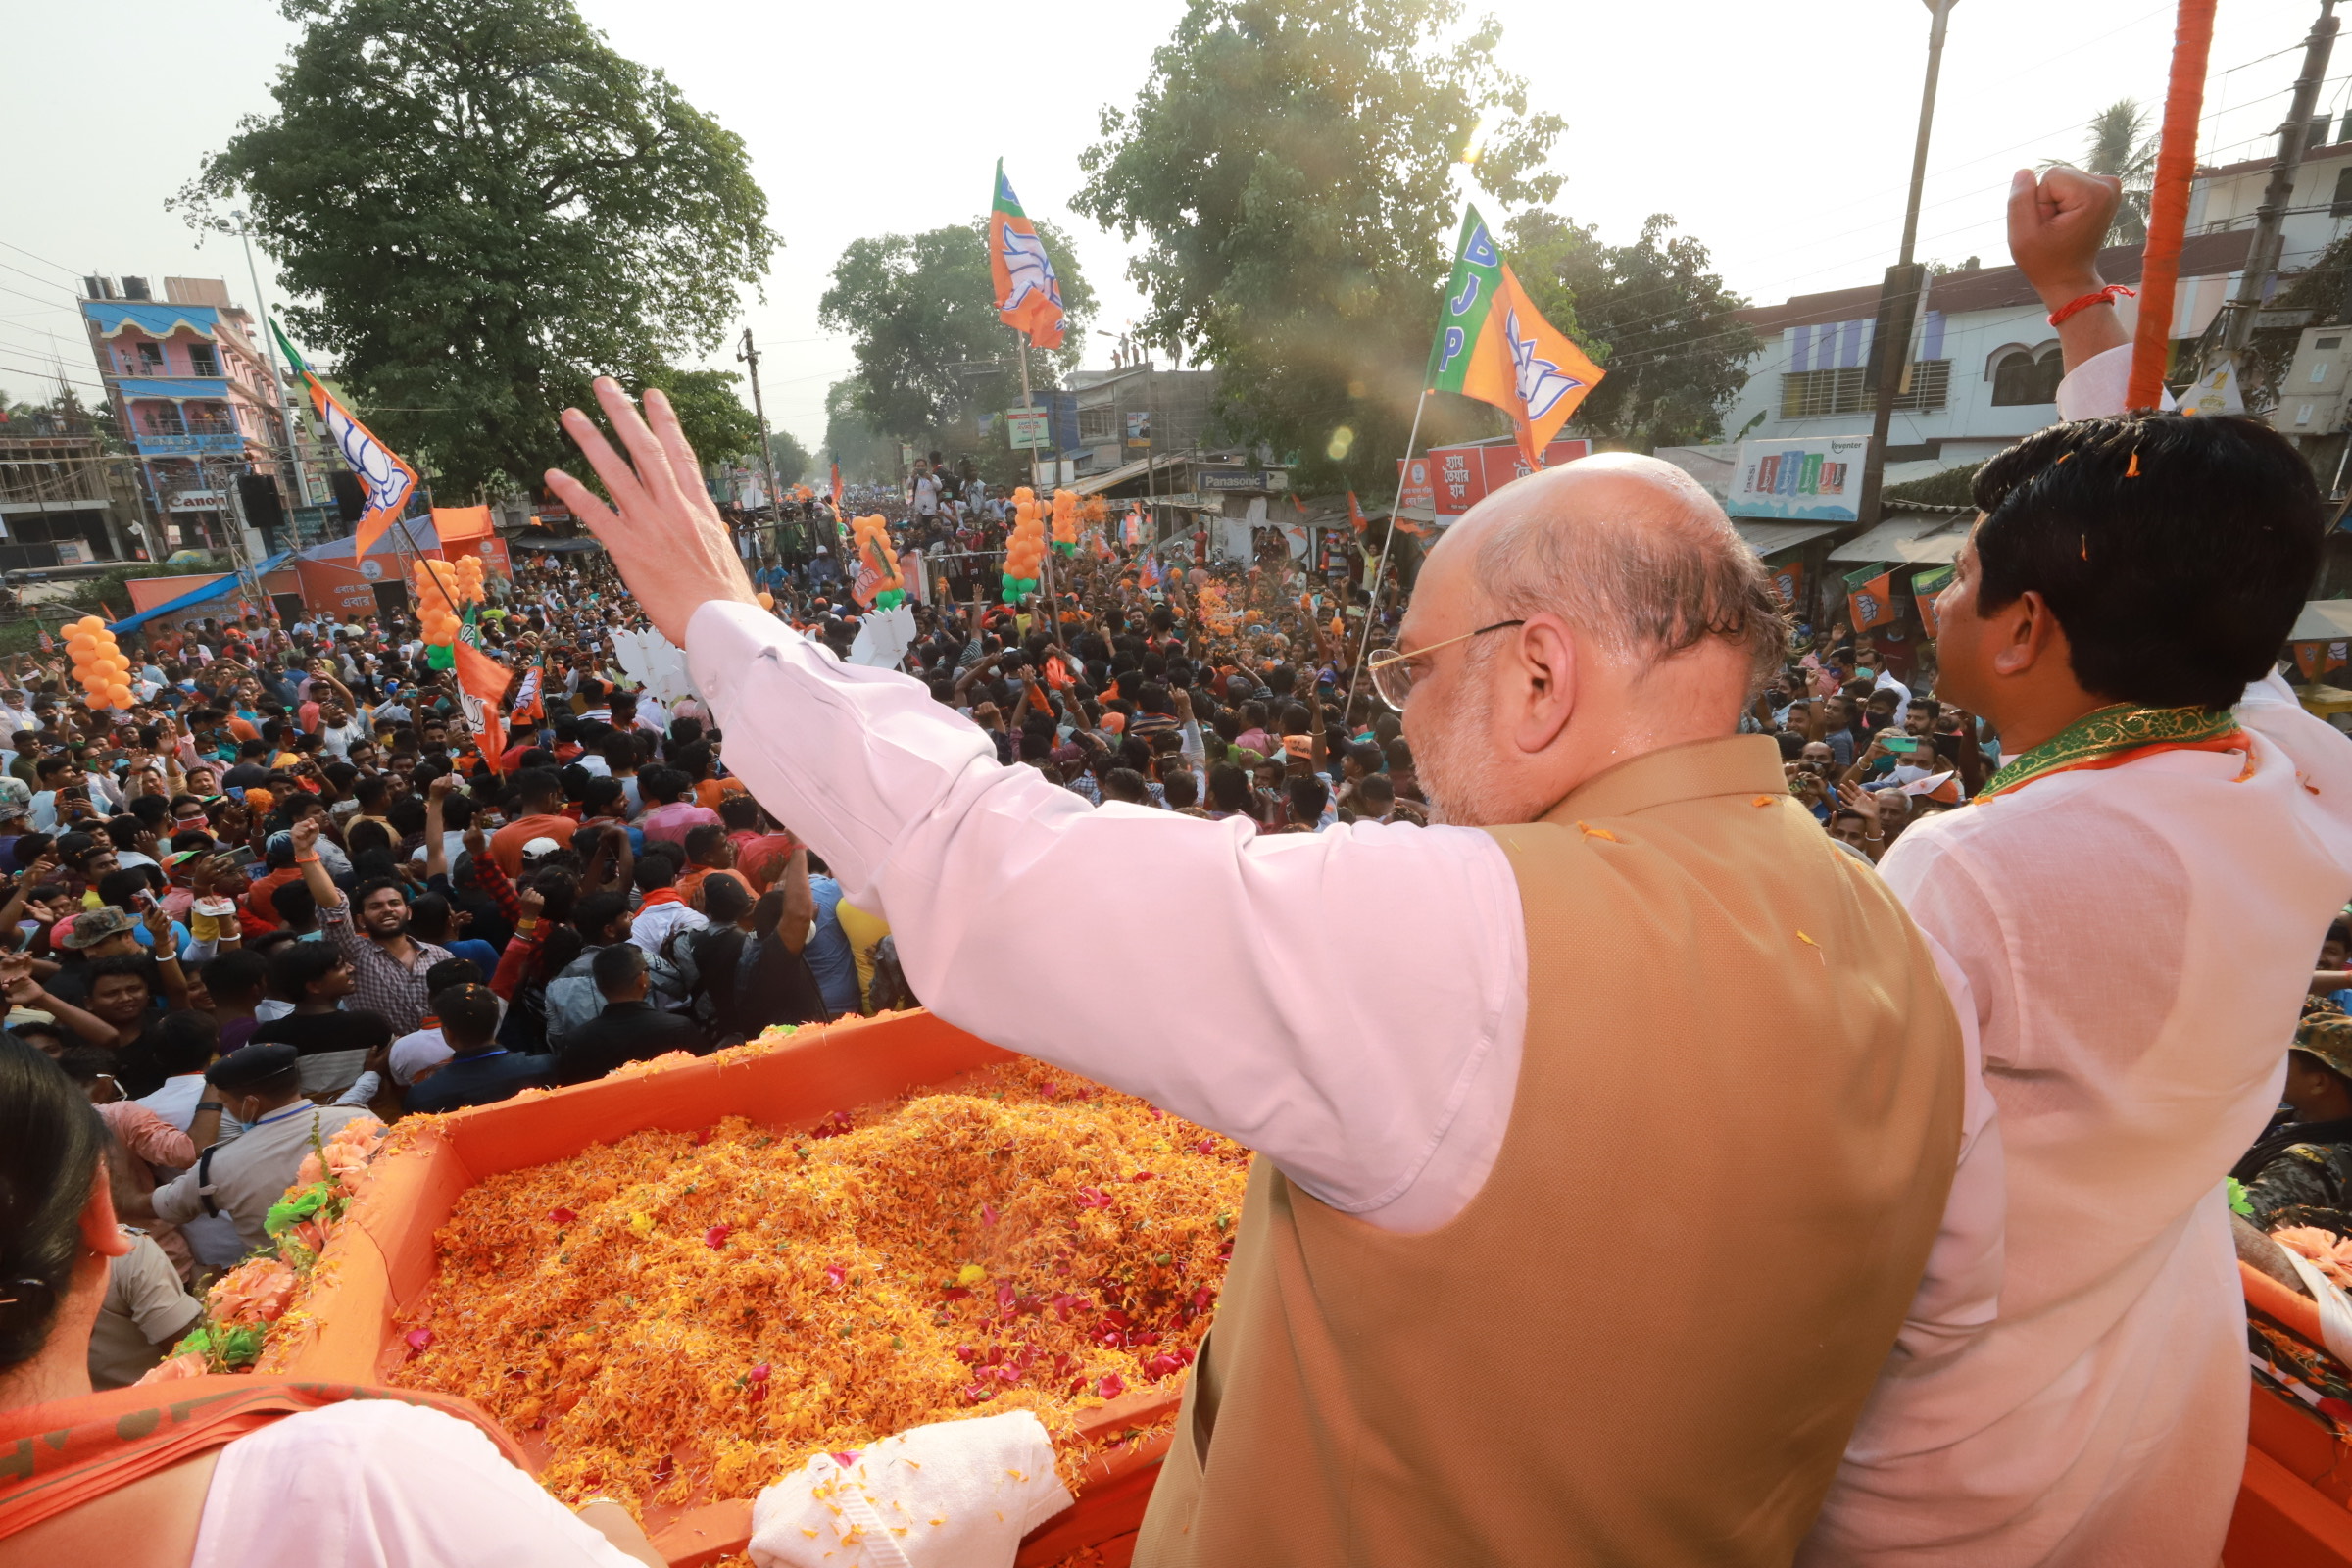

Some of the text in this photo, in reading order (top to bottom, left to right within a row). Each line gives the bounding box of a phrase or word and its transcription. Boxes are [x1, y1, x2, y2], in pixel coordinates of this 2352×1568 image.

[1205, 475, 1261, 487] Panasonic
[168, 494, 226, 507] Canon
[341, 596, 370, 608] এবার
